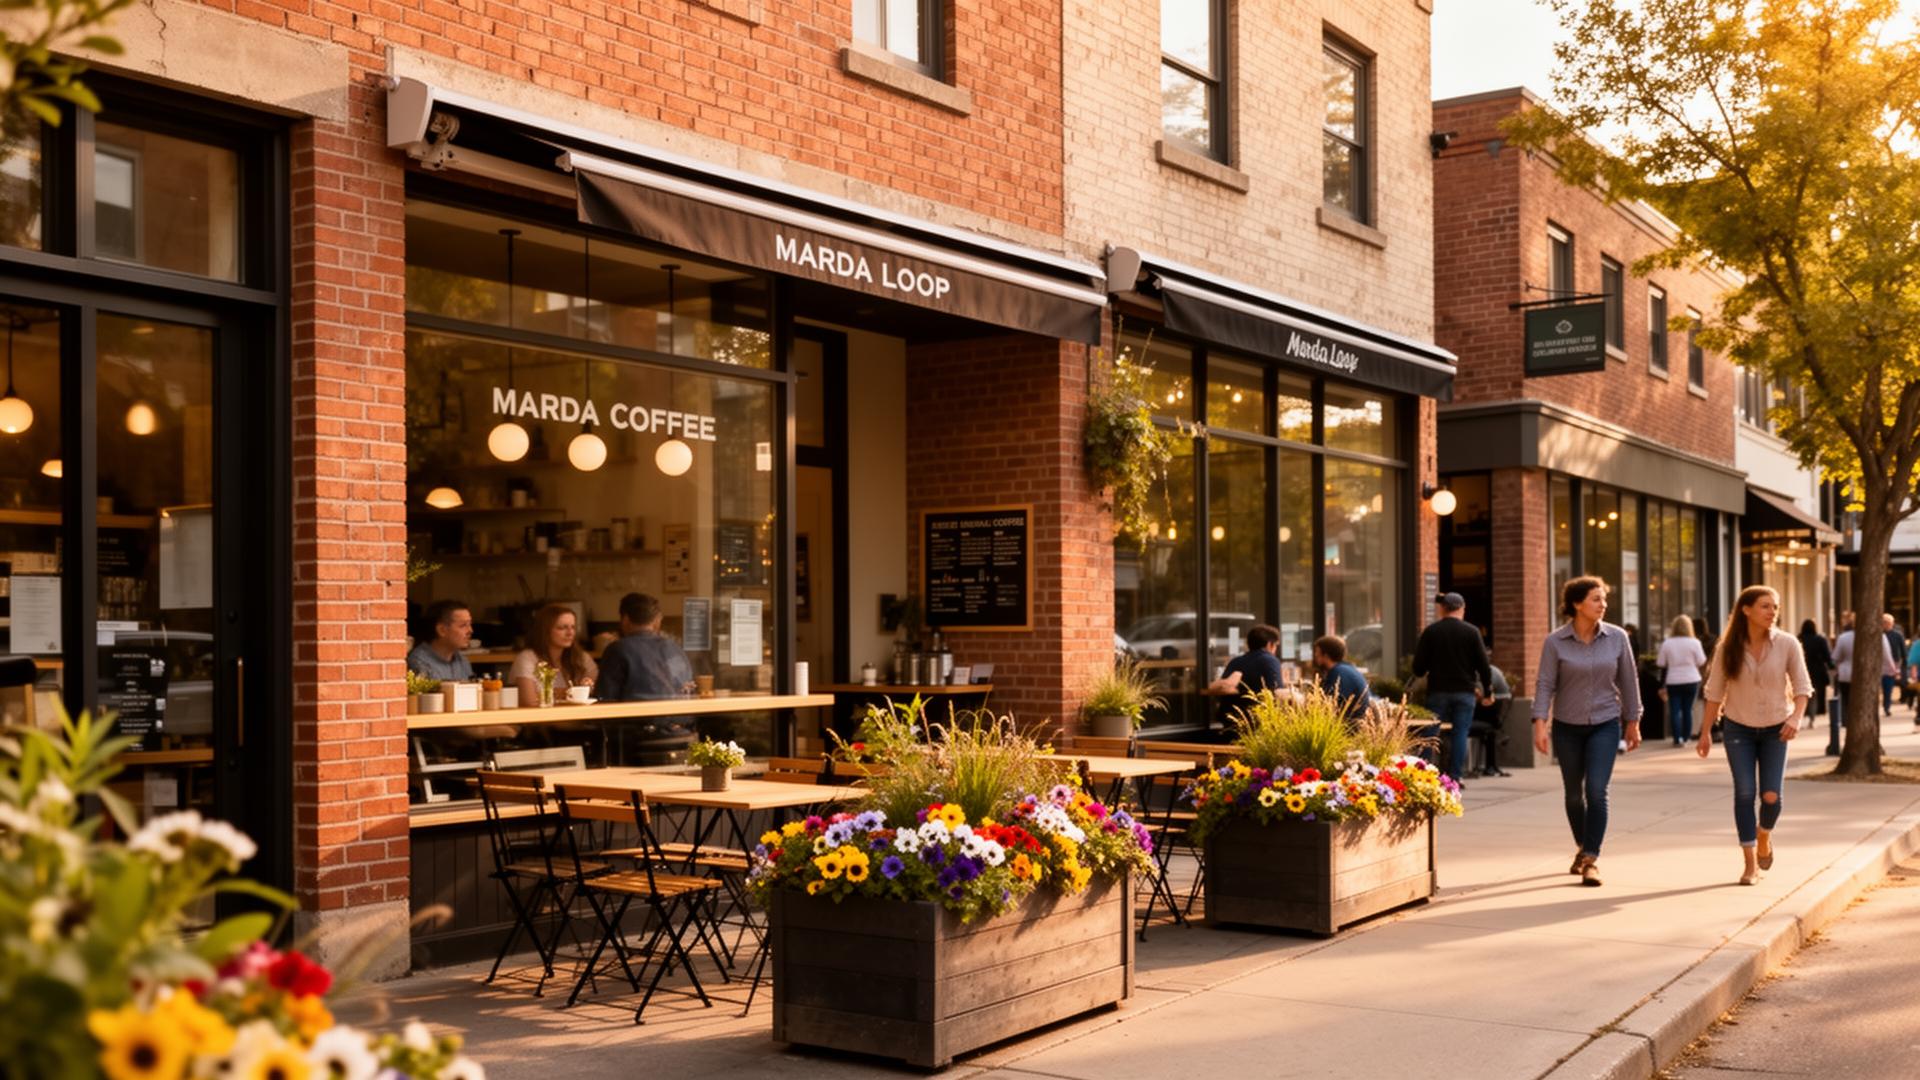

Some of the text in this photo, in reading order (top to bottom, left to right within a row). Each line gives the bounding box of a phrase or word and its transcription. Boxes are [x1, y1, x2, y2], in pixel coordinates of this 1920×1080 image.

[775, 234, 950, 299] MARDA LOOP
[492, 387, 717, 441] MARDA COFFEE
